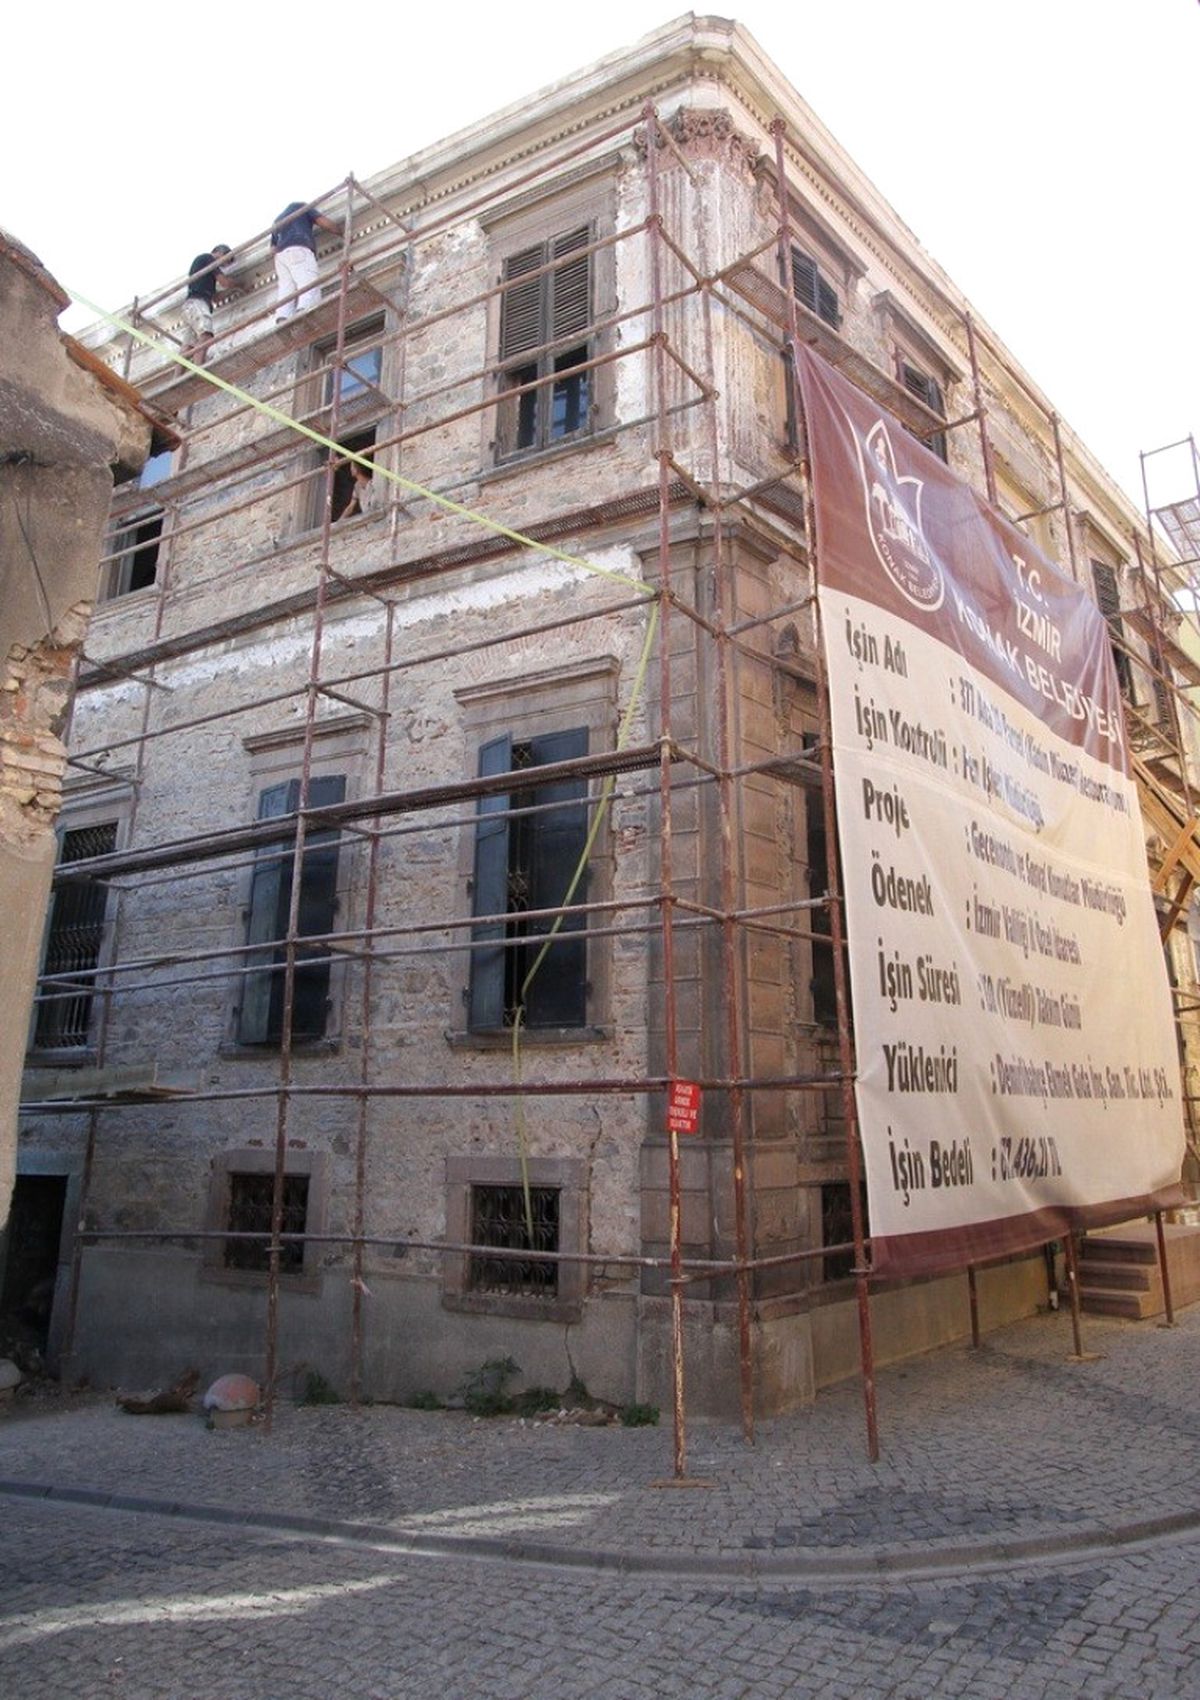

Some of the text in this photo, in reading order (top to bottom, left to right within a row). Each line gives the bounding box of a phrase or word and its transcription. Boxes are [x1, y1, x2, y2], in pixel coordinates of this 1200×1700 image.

[1013, 554, 1049, 607] T.C.
[845, 608, 879, 671] İşin
[884, 635, 908, 678] Adı
[1013, 588, 1062, 664] İZMİR
[957, 598, 1025, 680] KONAK
[1024, 655, 1122, 744] BELEDİYESİ
[854, 683, 888, 750] İşin
[862, 777, 910, 838] Proje
[871, 850, 934, 917] Ödenek
[973, 882, 1001, 939] İzmir
[878, 937, 913, 1013] İşin
[917, 954, 961, 1006] Süresi
[882, 1041, 958, 1093] Yüklenici
[887, 1125, 926, 1207] İşin
[930, 1136, 974, 1188] Bedeli
